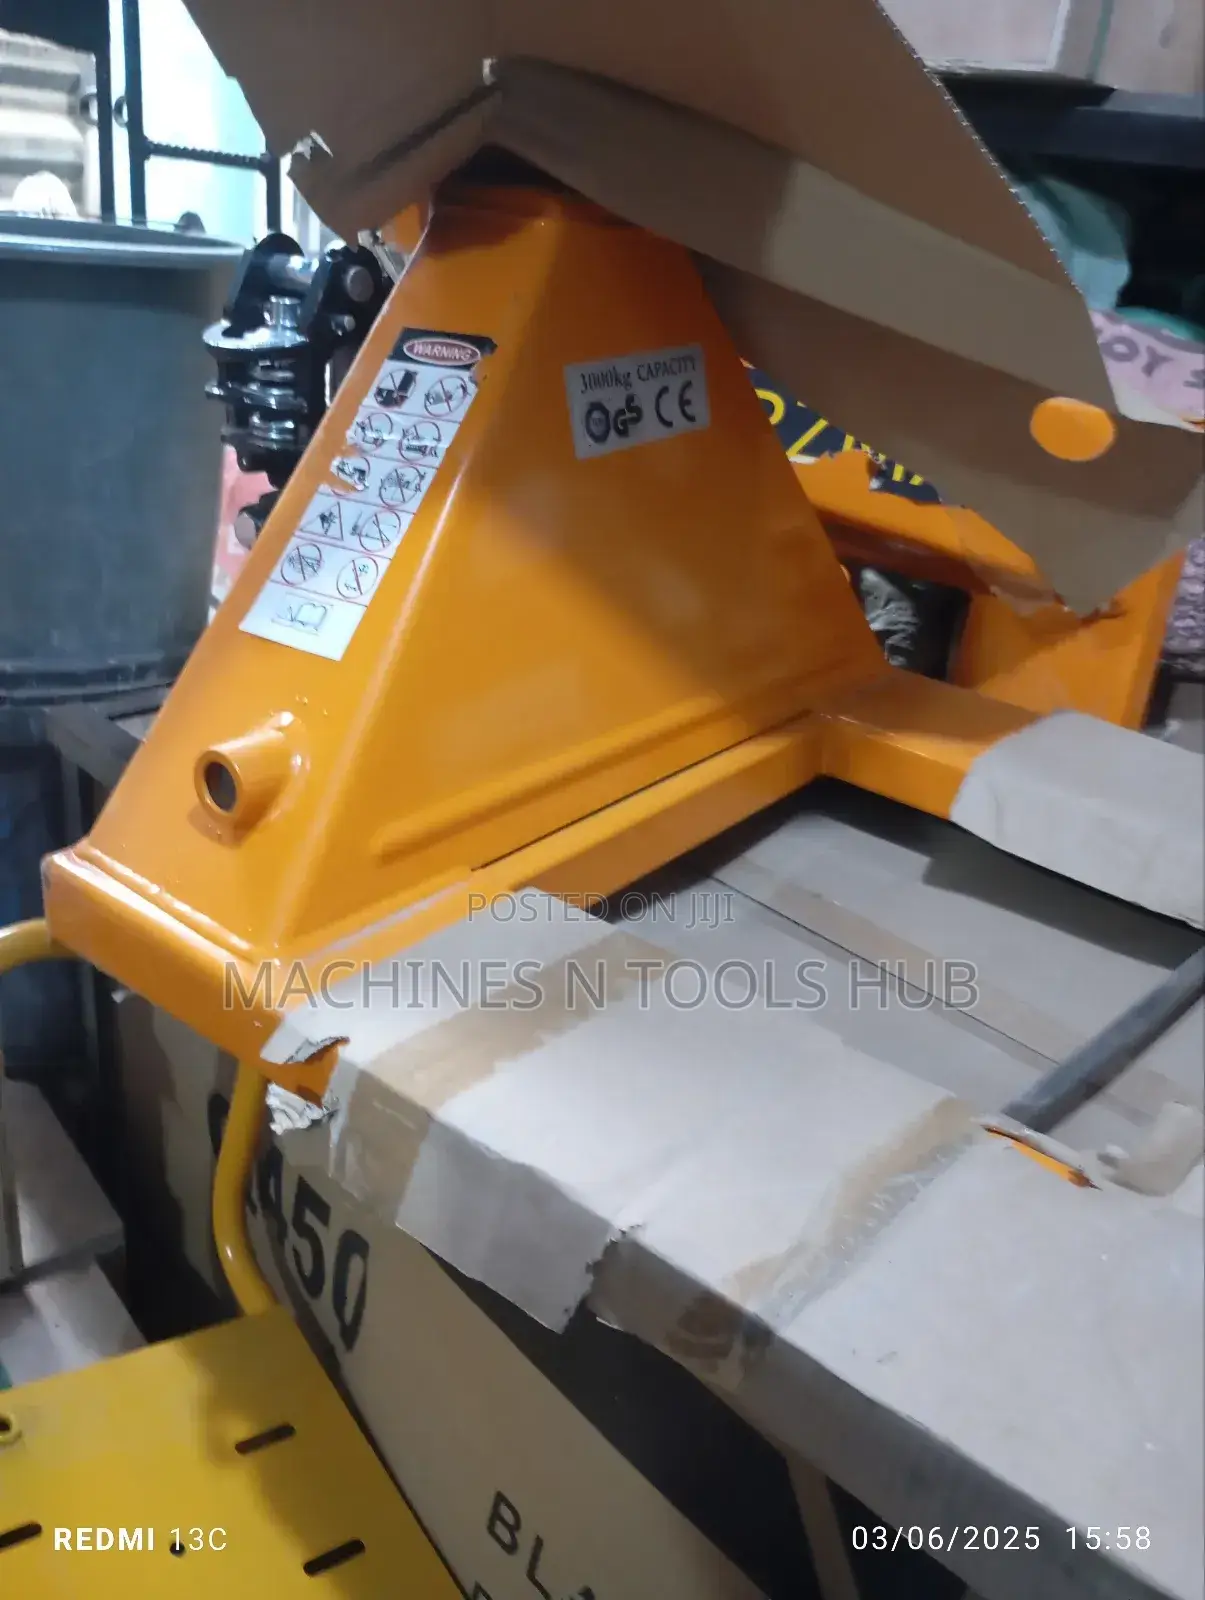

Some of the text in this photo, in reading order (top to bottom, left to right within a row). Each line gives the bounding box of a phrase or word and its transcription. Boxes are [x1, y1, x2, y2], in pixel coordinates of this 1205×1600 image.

[412, 340, 473, 361] WARNING
[1094, 325, 1175, 378] OY
[636, 354, 697, 383] CAPACITY
